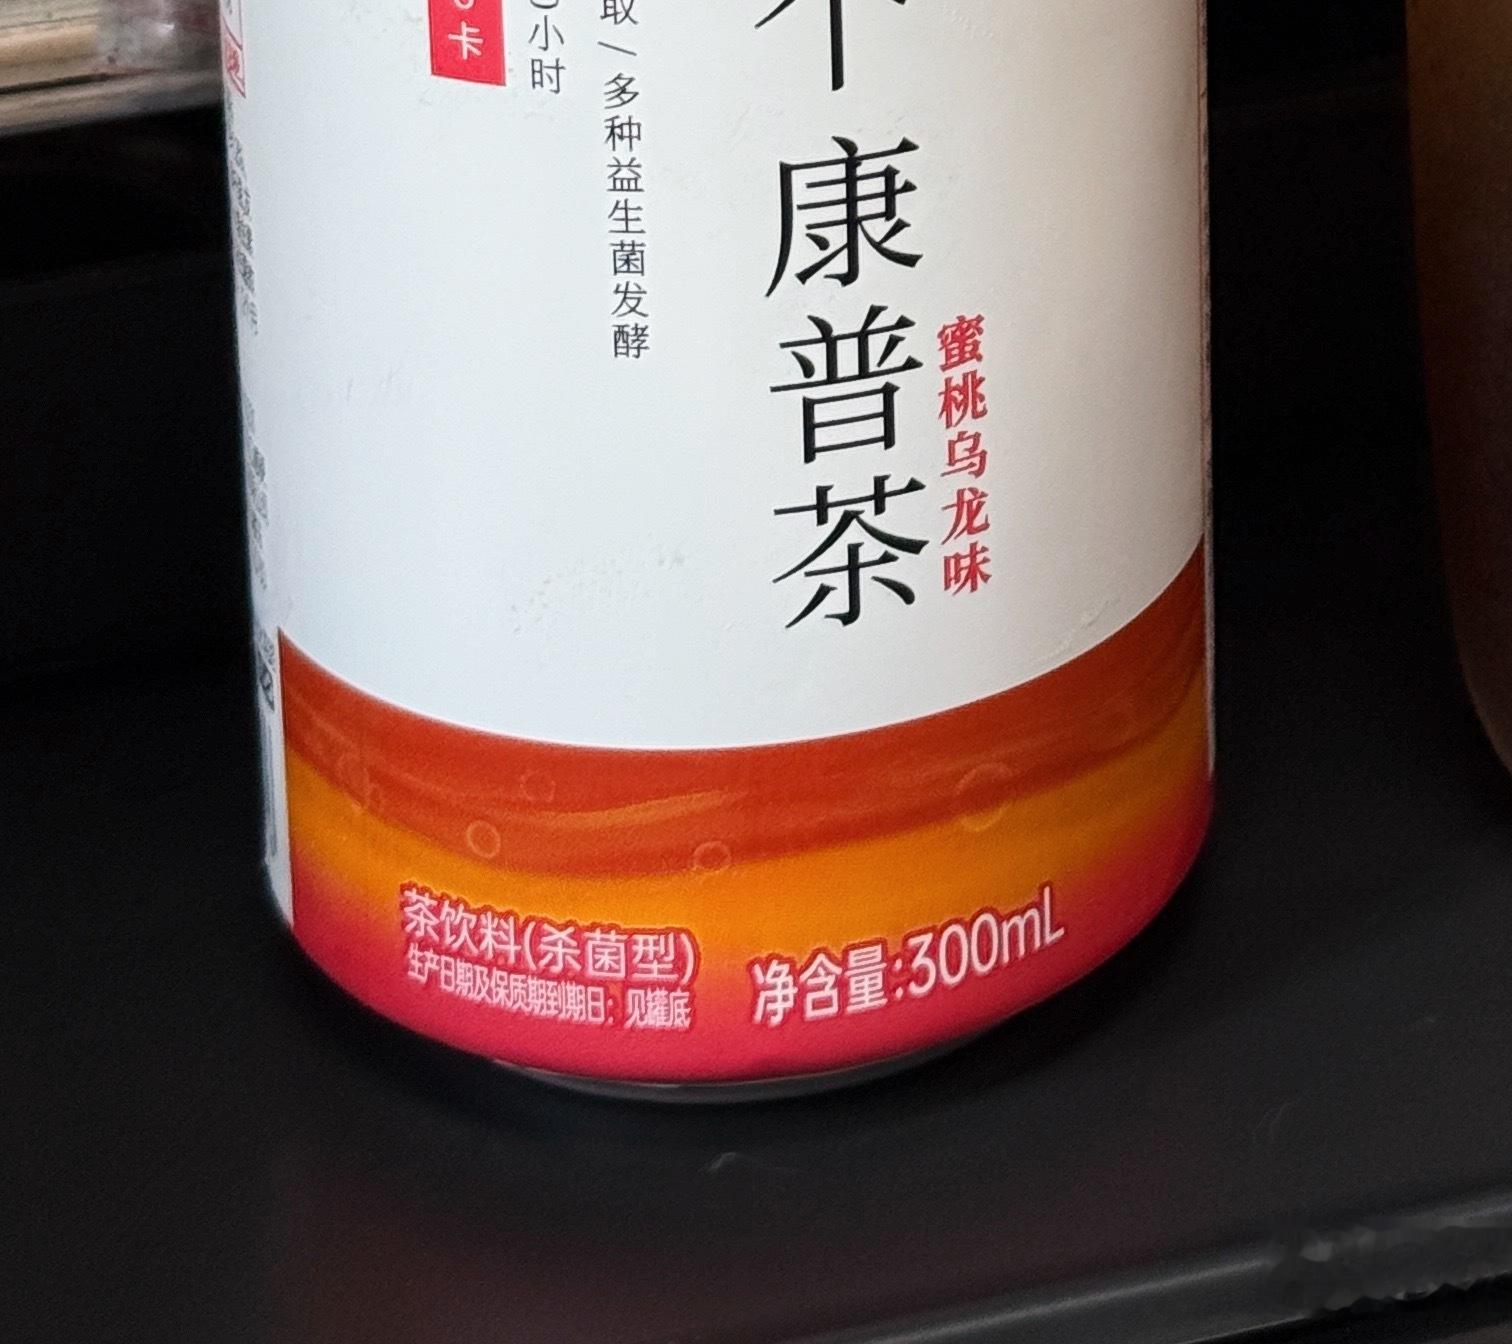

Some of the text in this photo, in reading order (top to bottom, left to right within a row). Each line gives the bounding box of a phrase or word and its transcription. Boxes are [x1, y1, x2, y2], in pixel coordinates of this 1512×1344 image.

[936, 313, 991, 596] 蜜桃乌龙味
[403, 887, 695, 985] 茶饮料(杀菌型)
